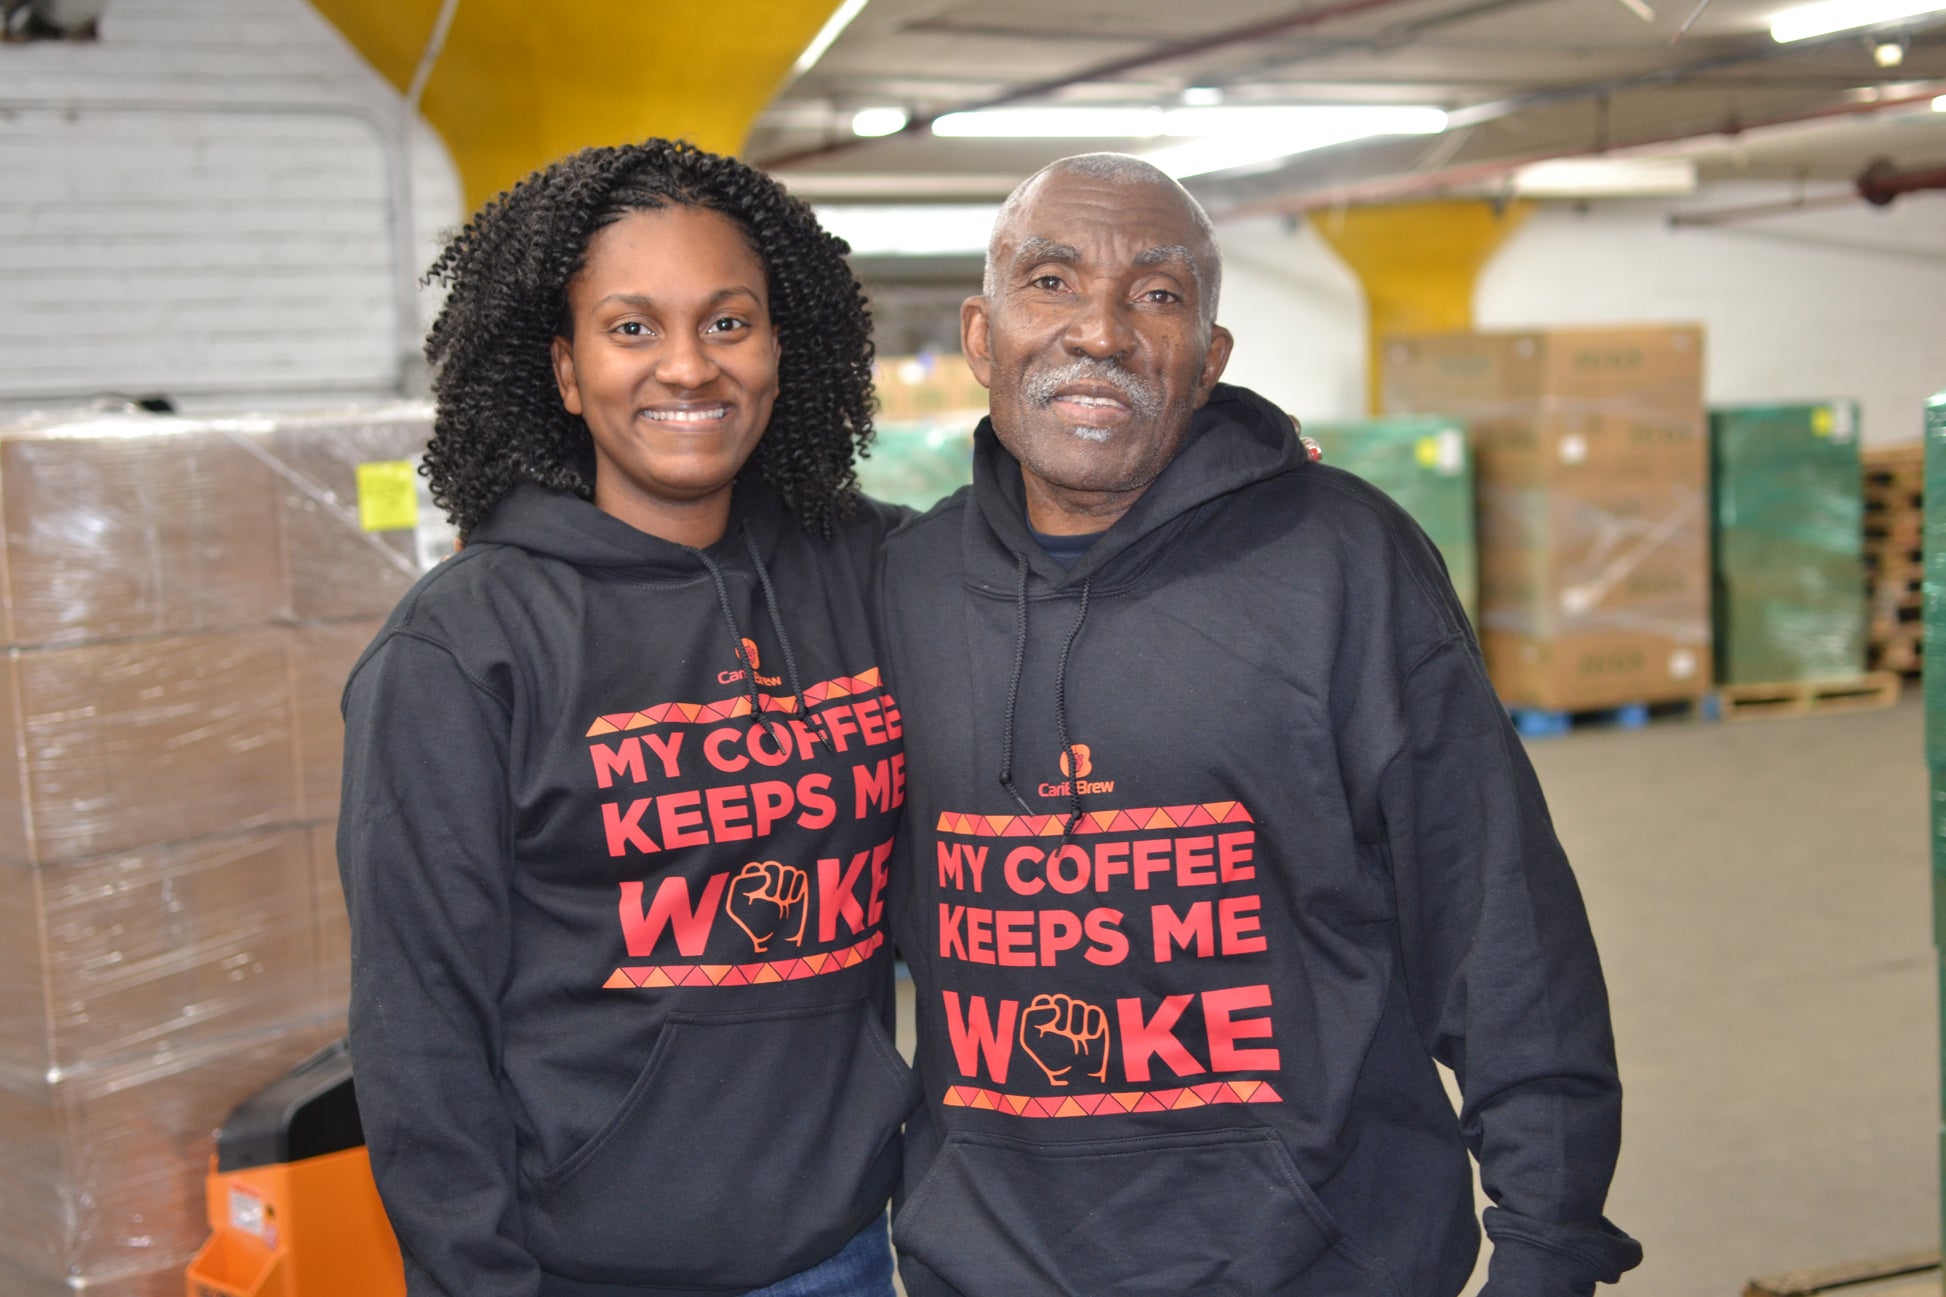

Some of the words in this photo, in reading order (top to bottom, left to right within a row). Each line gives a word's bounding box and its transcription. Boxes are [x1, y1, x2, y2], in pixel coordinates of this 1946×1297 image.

[588, 731, 685, 789] MY
[703, 694, 903, 773] COFFEE
[601, 772, 837, 858] KEEPS
[852, 751, 905, 820] ME
[618, 834, 895, 957] WKE
[936, 840, 989, 893] MY
[1003, 830, 1256, 896] COFFEE
[938, 903, 1130, 967] KEEPS
[1150, 894, 1267, 964] ME
[942, 983, 1281, 1087] WKE
